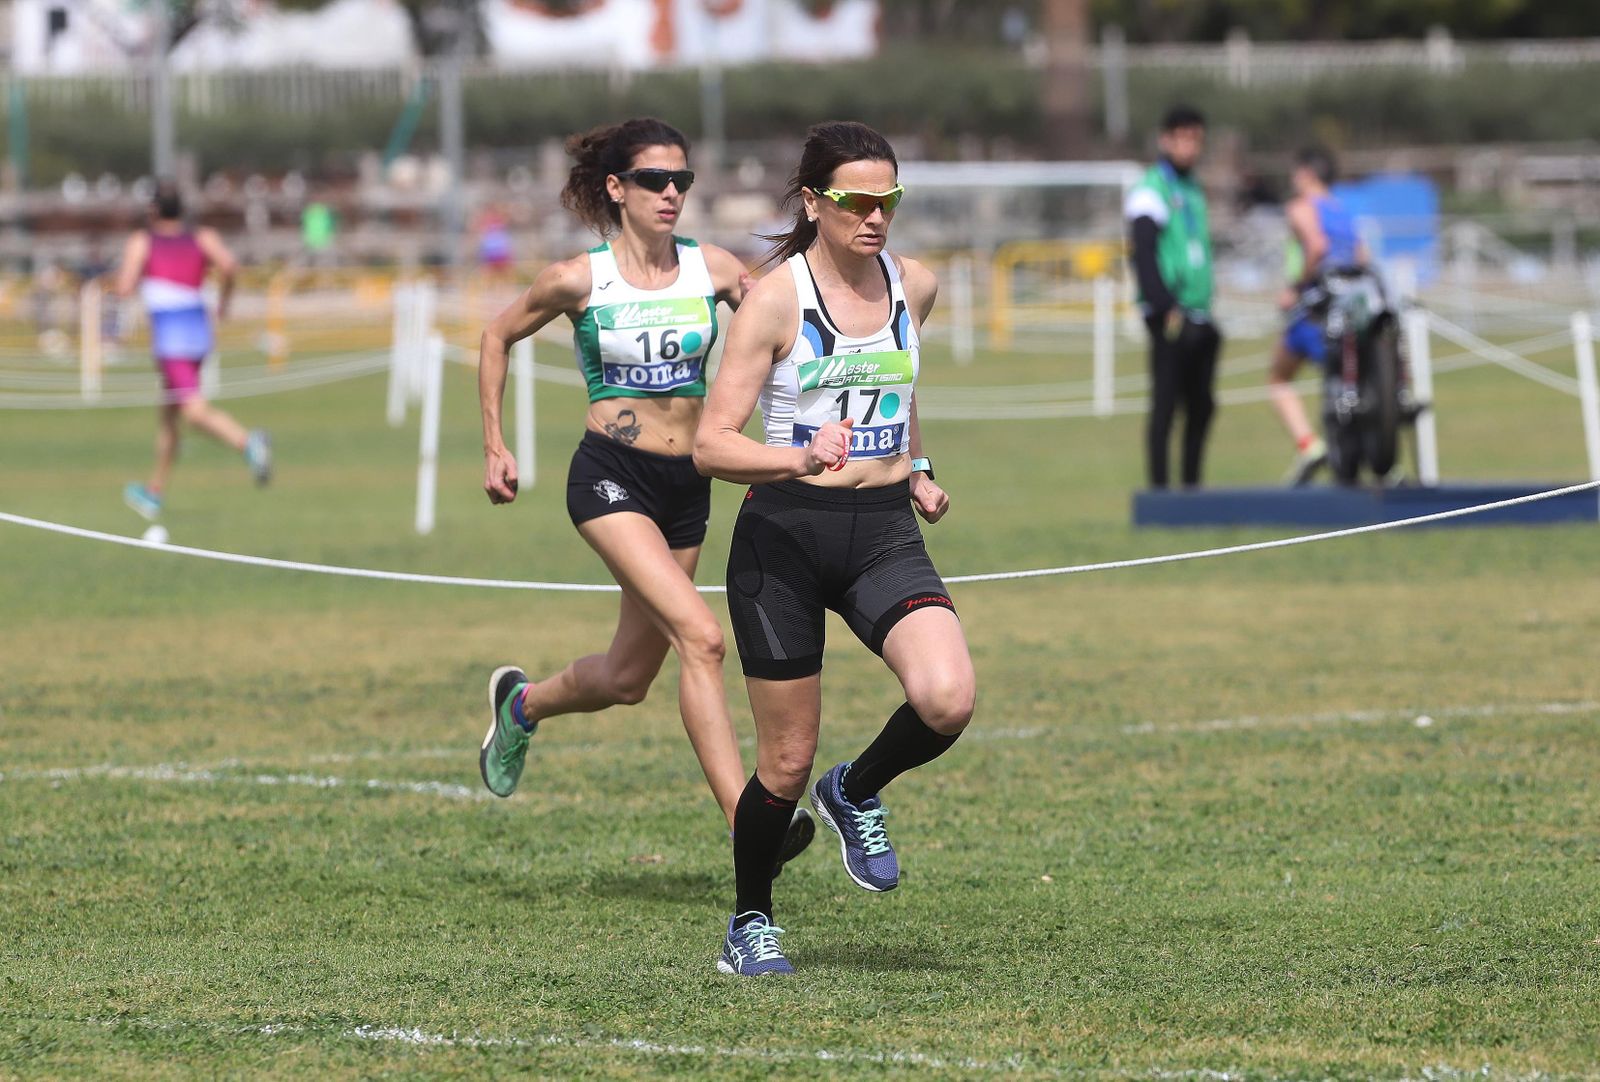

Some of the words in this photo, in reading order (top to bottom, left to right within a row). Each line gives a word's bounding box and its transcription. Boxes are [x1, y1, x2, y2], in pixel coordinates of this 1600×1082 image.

[635, 329, 680, 363] 16
[614, 361, 691, 385] Joma
[819, 357, 880, 377] Master
[845, 373, 903, 384] ATLETISMO
[835, 388, 881, 425] 17
[803, 427, 895, 451] Jma
